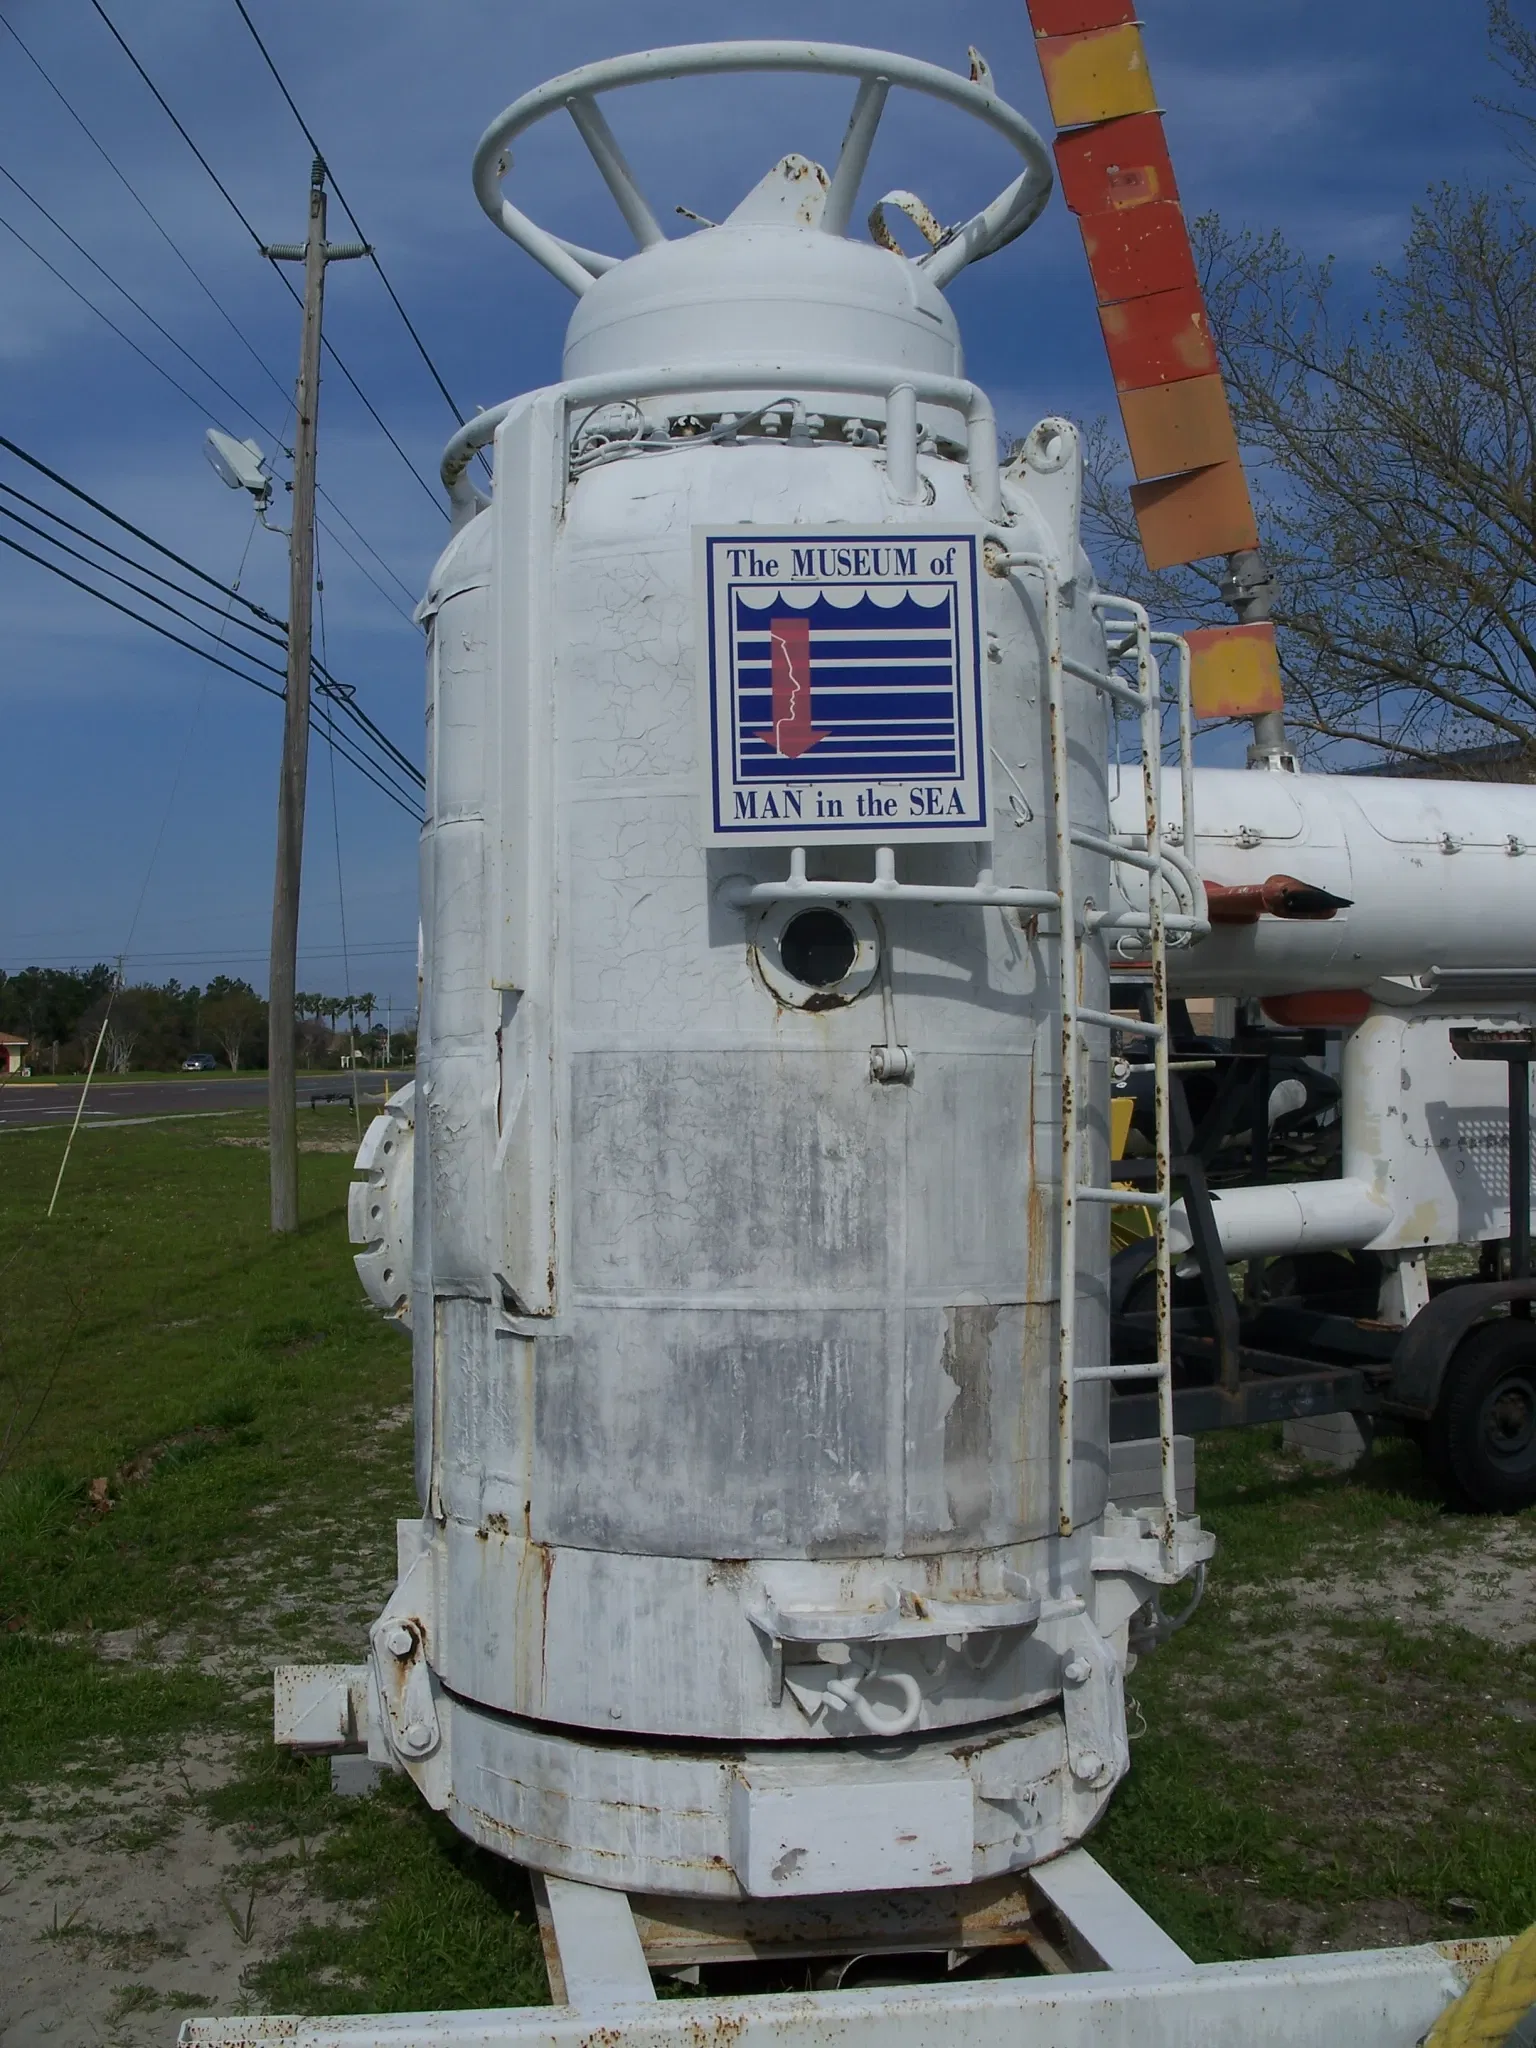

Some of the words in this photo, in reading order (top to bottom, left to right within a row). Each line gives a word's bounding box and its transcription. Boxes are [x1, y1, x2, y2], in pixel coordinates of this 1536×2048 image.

[727, 549, 780, 577] The
[791, 548, 918, 577] MUSEUM
[930, 547, 956, 575] of
[733, 790, 803, 819] MAN
[816, 791, 844, 818] in
[857, 788, 898, 817] the
[910, 787, 966, 816] SEA
